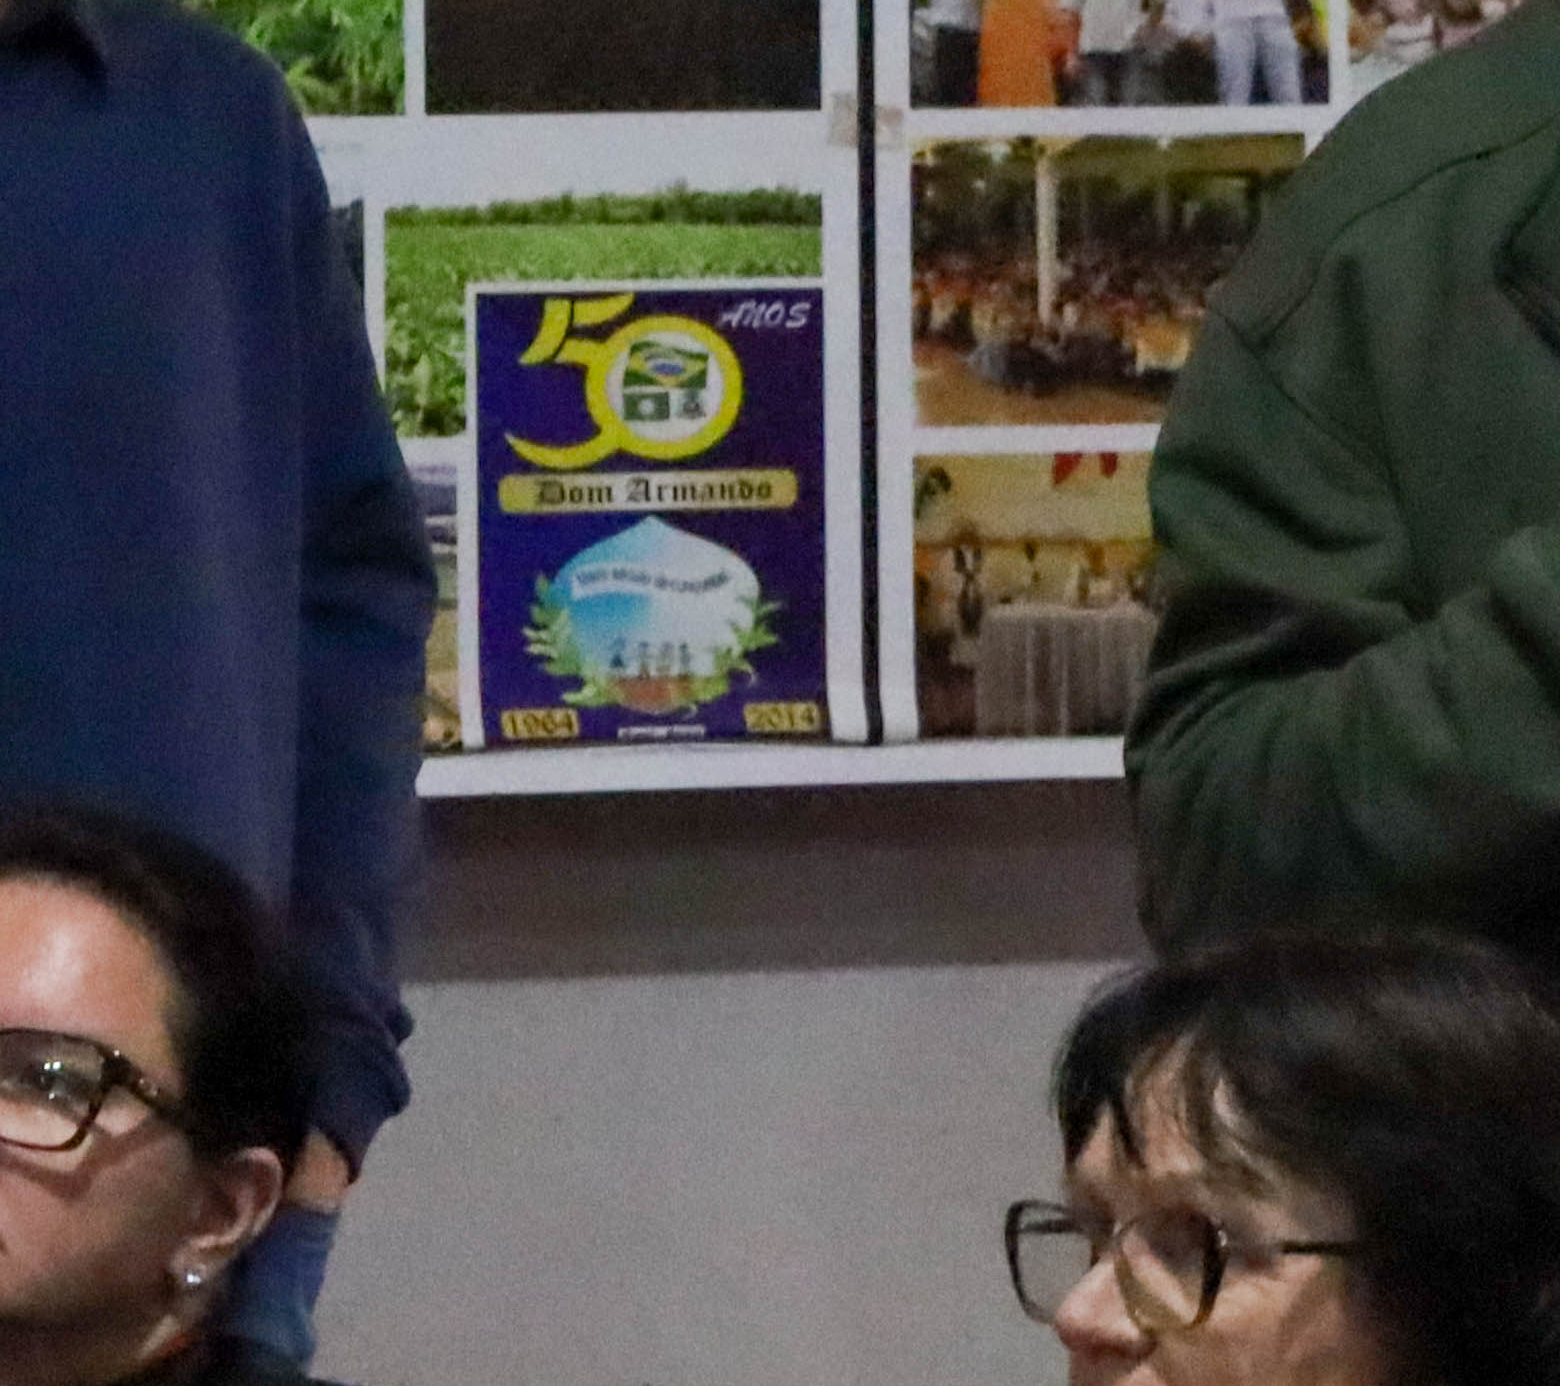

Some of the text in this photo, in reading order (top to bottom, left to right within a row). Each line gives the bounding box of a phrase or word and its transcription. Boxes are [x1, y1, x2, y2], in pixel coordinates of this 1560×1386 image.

[503, 293, 743, 470] 50
[533, 475, 773, 507] Dom Armando
[506, 703, 818, 738] 1964 2014
